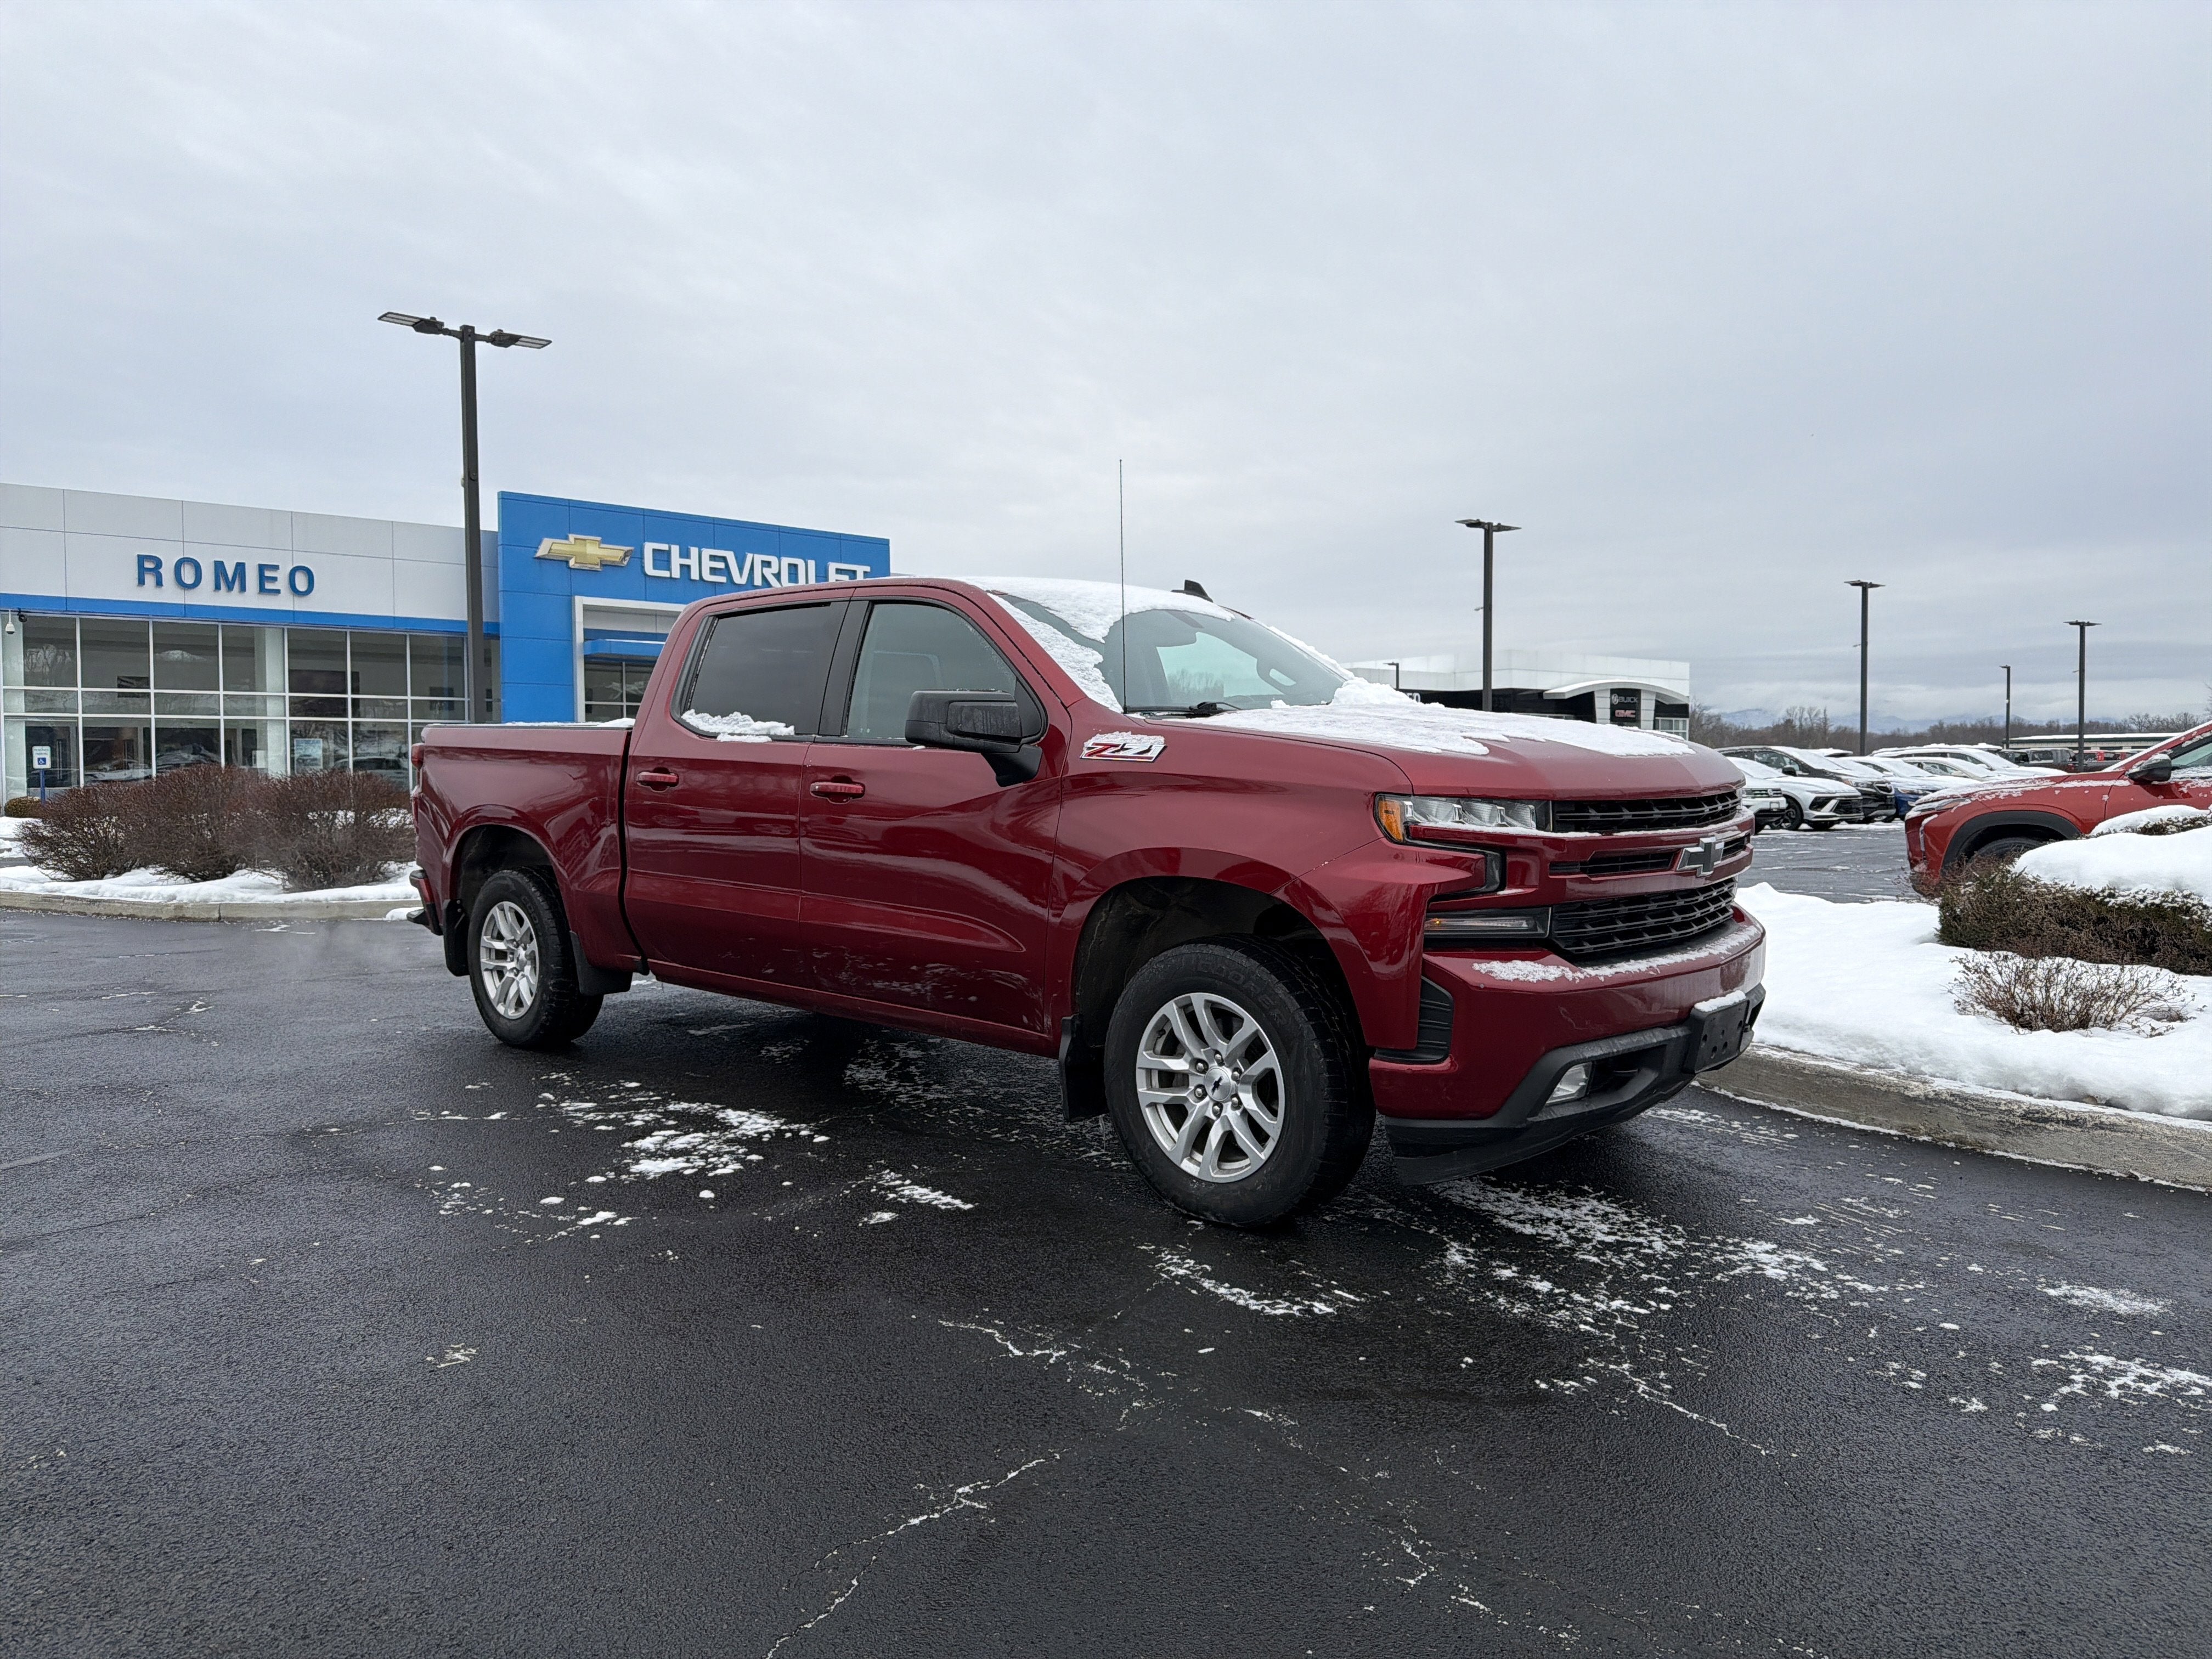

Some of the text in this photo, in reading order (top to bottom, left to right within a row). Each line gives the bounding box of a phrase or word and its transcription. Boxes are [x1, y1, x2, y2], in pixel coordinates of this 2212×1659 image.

[137, 554, 315, 596] ROMEO
[1615, 709, 1636, 718] GMC
[1080, 742, 1167, 762] Z71
